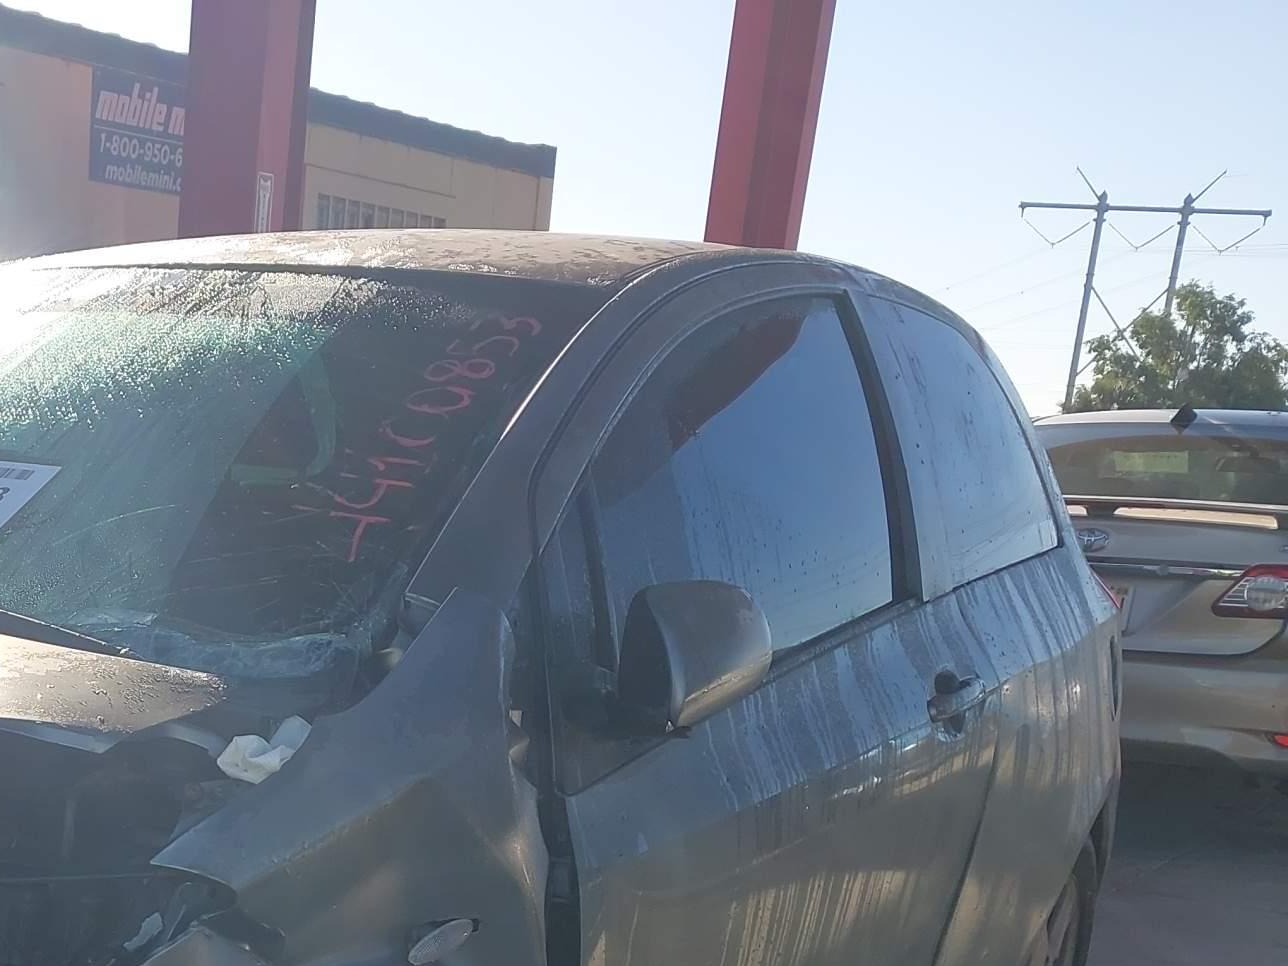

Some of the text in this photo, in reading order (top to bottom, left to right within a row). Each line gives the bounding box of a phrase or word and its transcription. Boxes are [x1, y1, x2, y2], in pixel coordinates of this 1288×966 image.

[95, 82, 168, 131] mobile
[99, 132, 183, 167] 1-800-950-6
[105, 163, 181, 192] mobilemini.c
